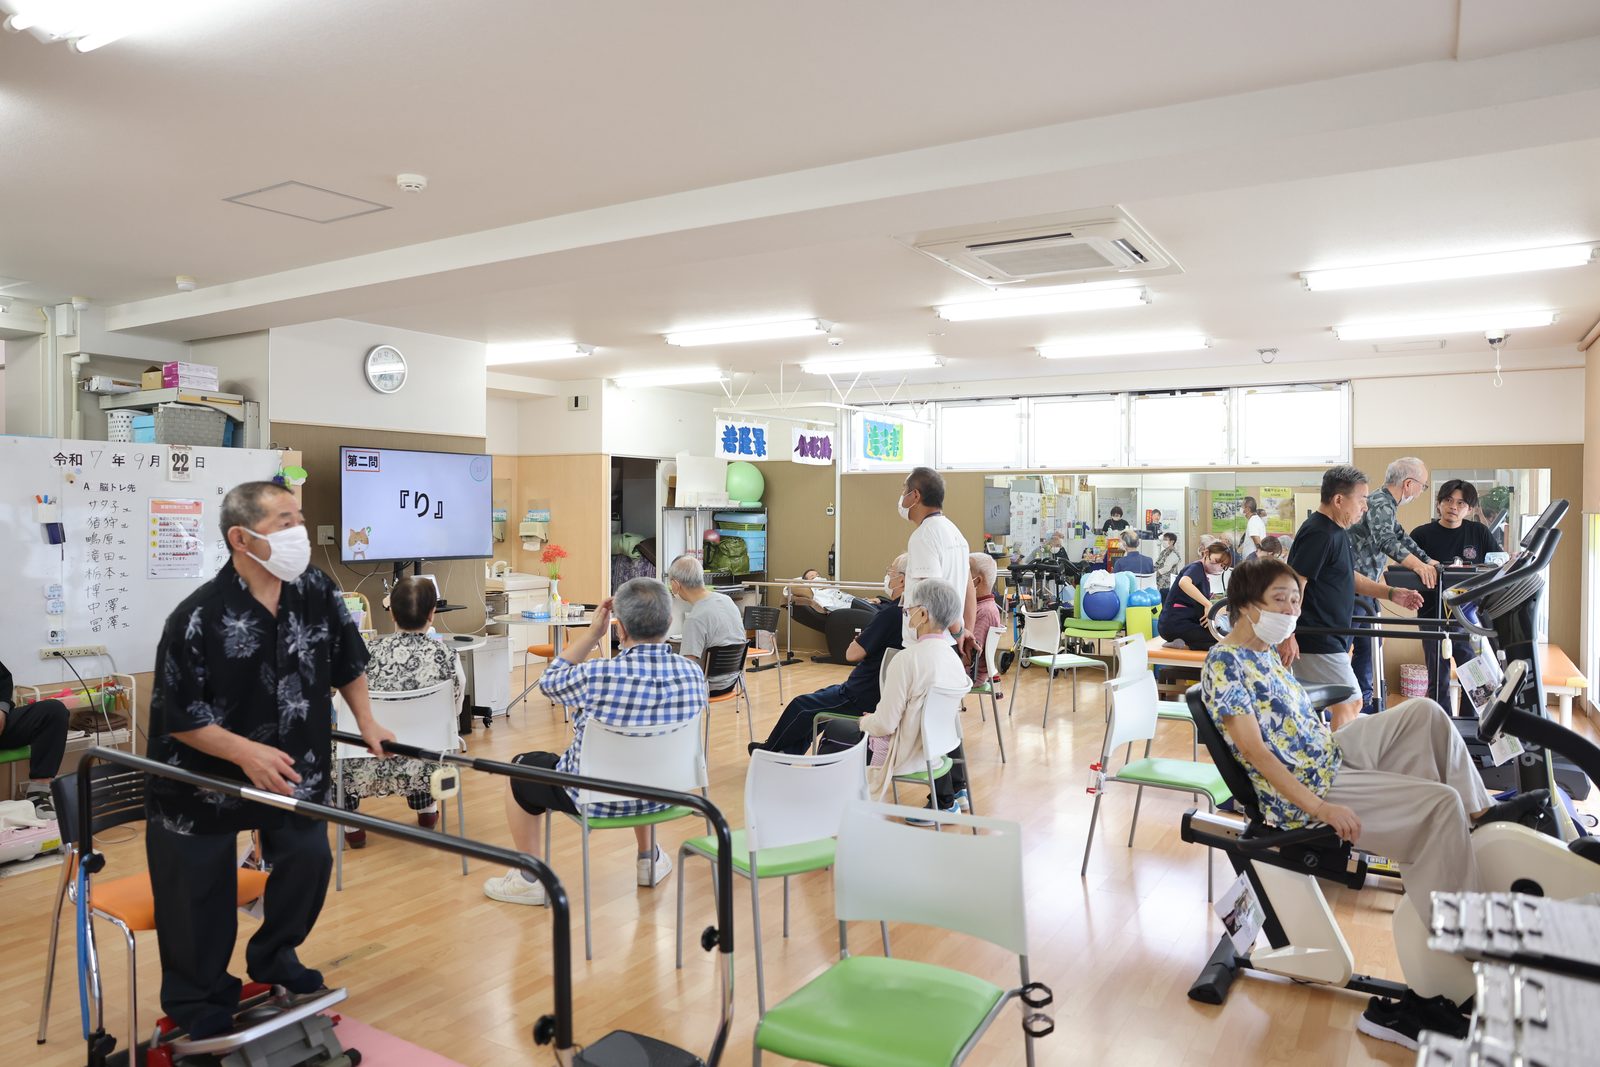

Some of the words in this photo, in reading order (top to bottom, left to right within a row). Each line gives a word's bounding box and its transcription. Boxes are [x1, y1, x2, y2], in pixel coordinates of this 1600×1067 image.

[53, 452, 82, 466] 令和
[112, 454, 126, 467] 年
[150, 455, 160, 468] 月
[172, 453, 189, 472] 22
[196, 456, 205, 468] 日
[348, 454, 378, 468] 第二問
[84, 482, 90, 491] A
[100, 482, 136, 492] 脳トレ先
[400, 490, 443, 520] 『り』
